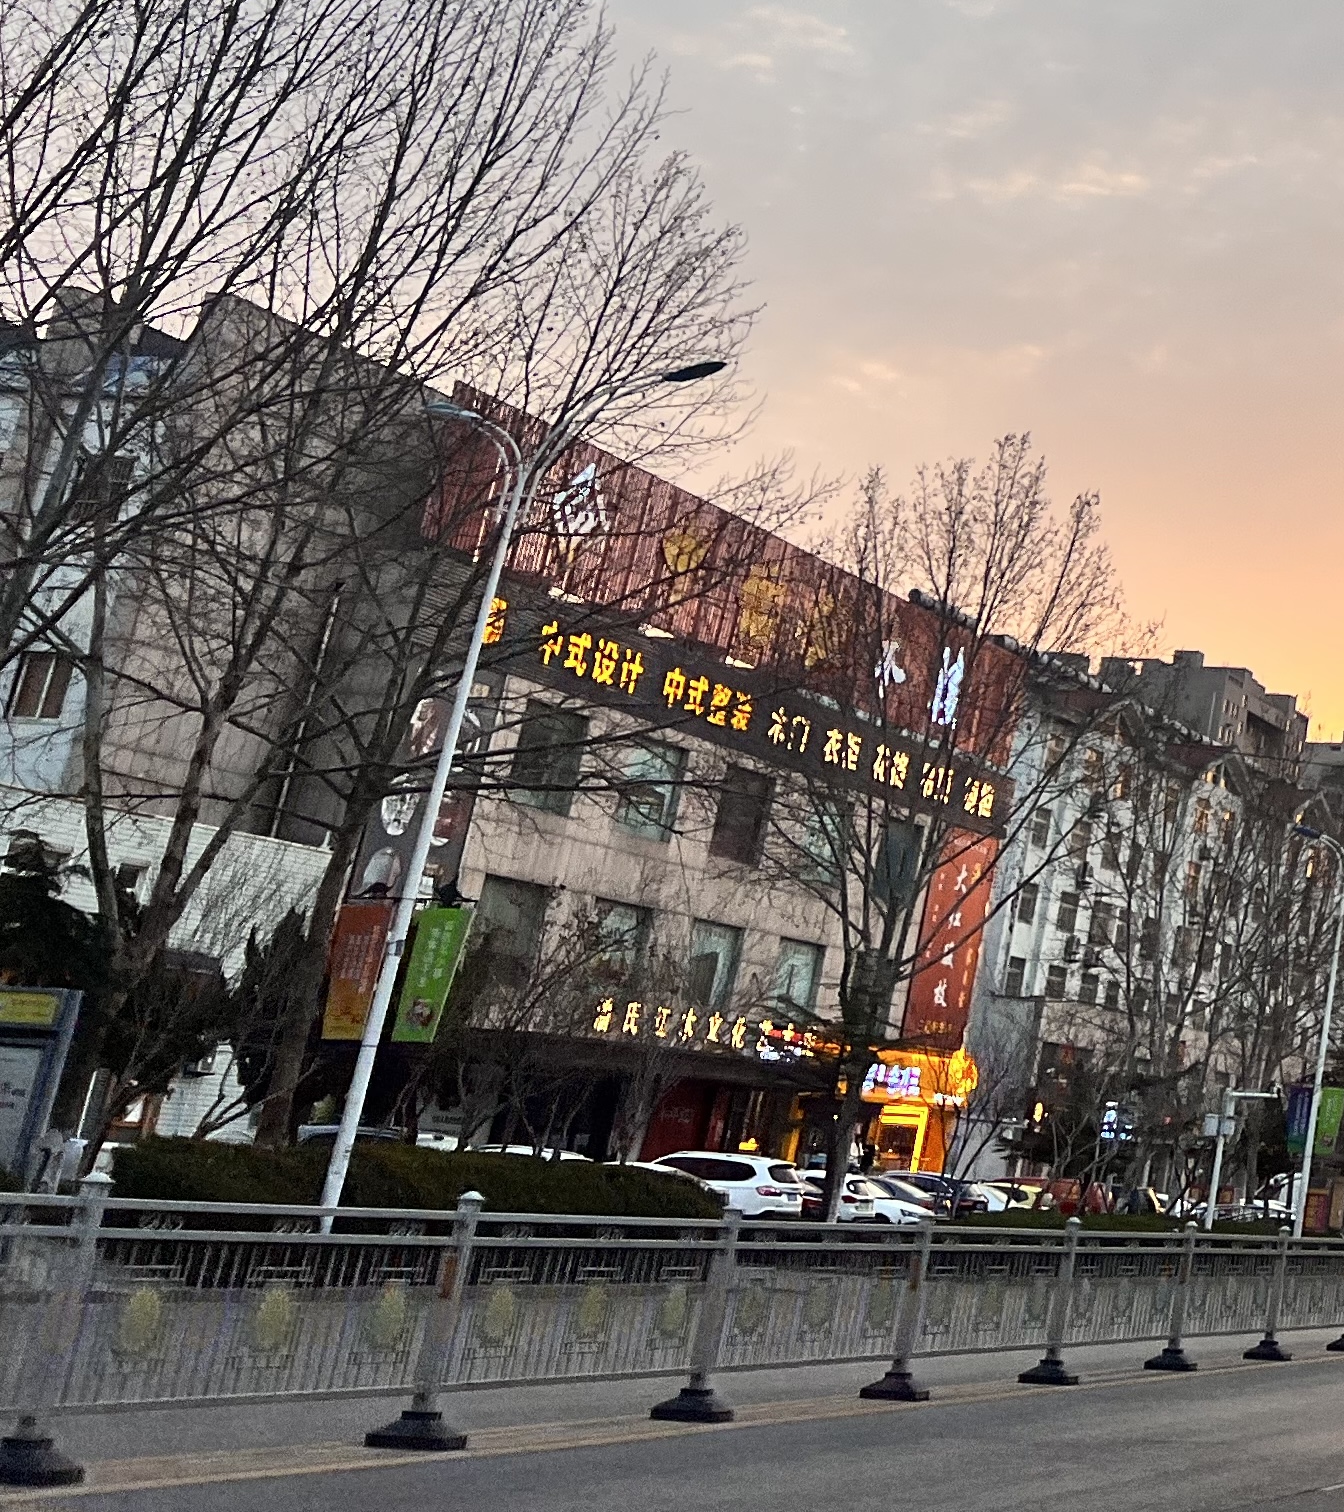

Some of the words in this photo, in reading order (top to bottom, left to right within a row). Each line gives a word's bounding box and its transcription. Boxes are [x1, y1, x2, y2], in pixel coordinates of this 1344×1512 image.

[661, 666, 754, 732] 中式整装
[767, 706, 811, 753] 木门
